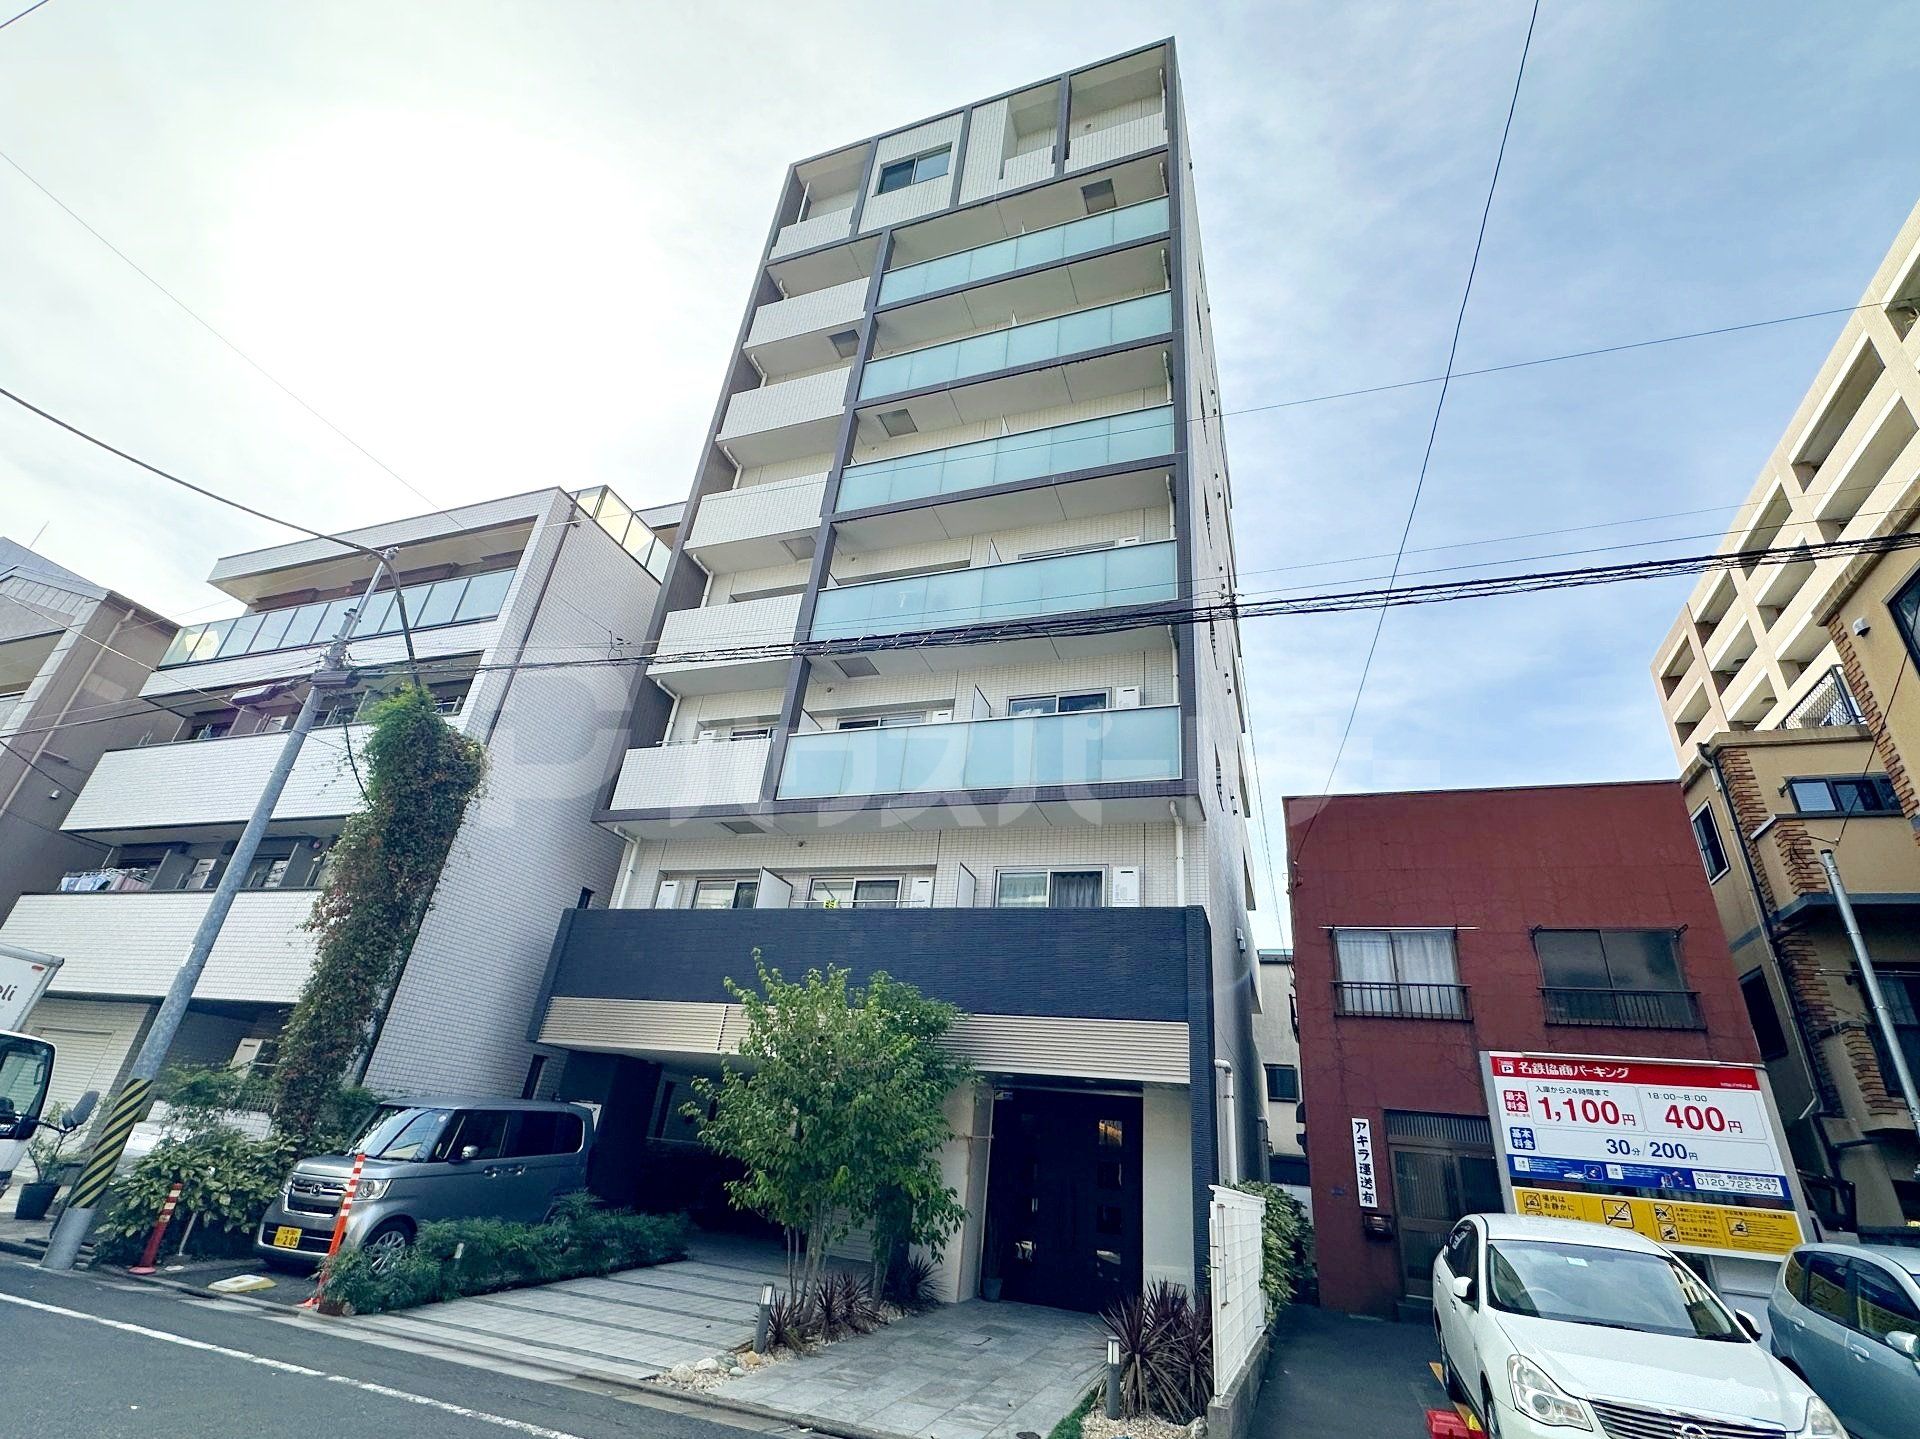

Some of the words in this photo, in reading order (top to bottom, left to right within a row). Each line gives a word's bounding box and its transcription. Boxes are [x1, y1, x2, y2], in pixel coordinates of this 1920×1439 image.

[1518, 1061, 1630, 1079] 名鉄協商パーキング
[1505, 1091, 1526, 1102] 最大
[1535, 1086, 1609, 1097] 入庫から24時間まで
[1507, 1101, 1528, 1111] 料金
[1665, 1104, 1743, 1133] 400円
[1513, 1138, 1534, 1149] 料金
[1354, 1121, 1375, 1204] アキラ運送有
[1697, 1177, 1778, 1191] 0120-722-247
